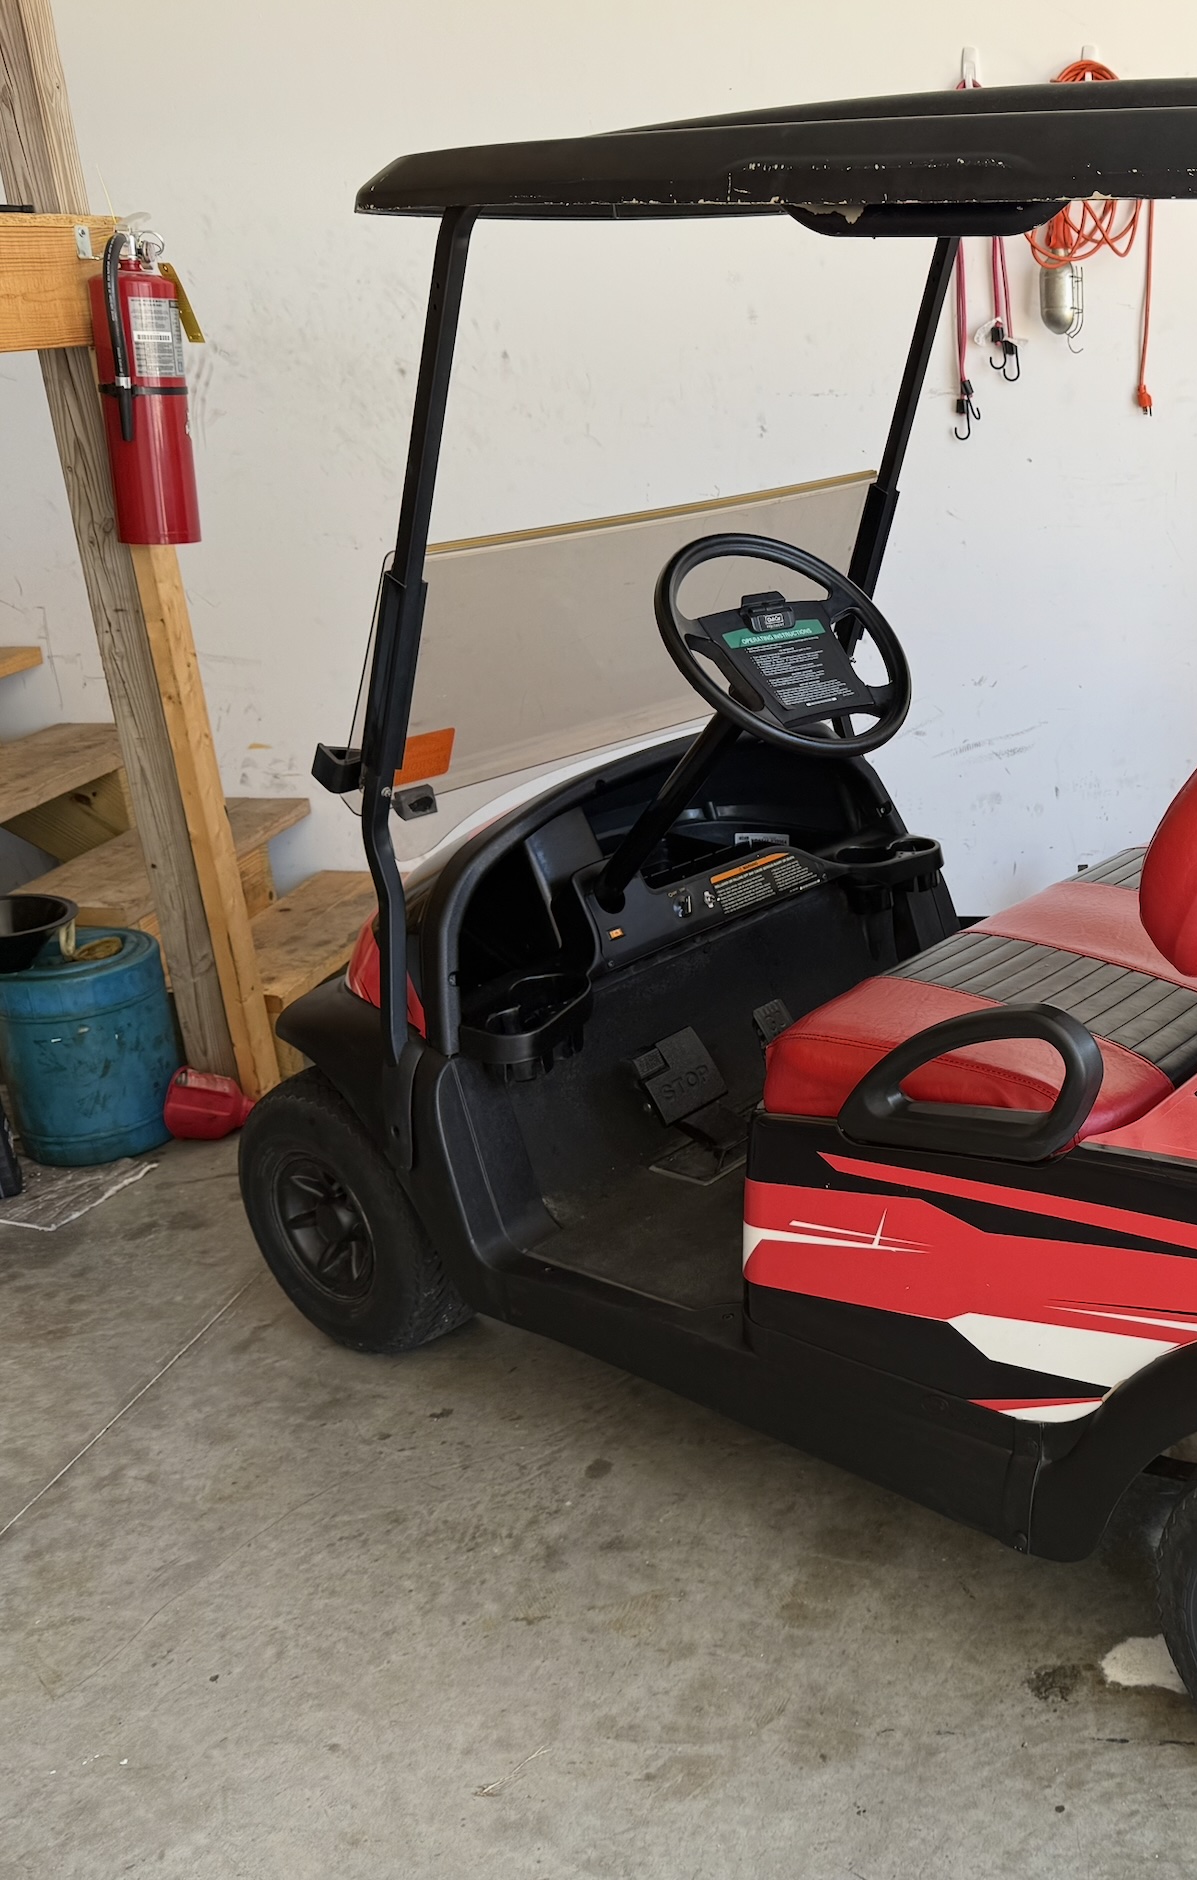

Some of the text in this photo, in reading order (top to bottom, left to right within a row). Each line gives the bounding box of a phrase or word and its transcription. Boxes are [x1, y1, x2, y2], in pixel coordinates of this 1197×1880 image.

[741, 634, 774, 645] OPERATING
[773, 628, 812, 640] INSTRUCTIONS
[661, 1064, 709, 1101] STOP
